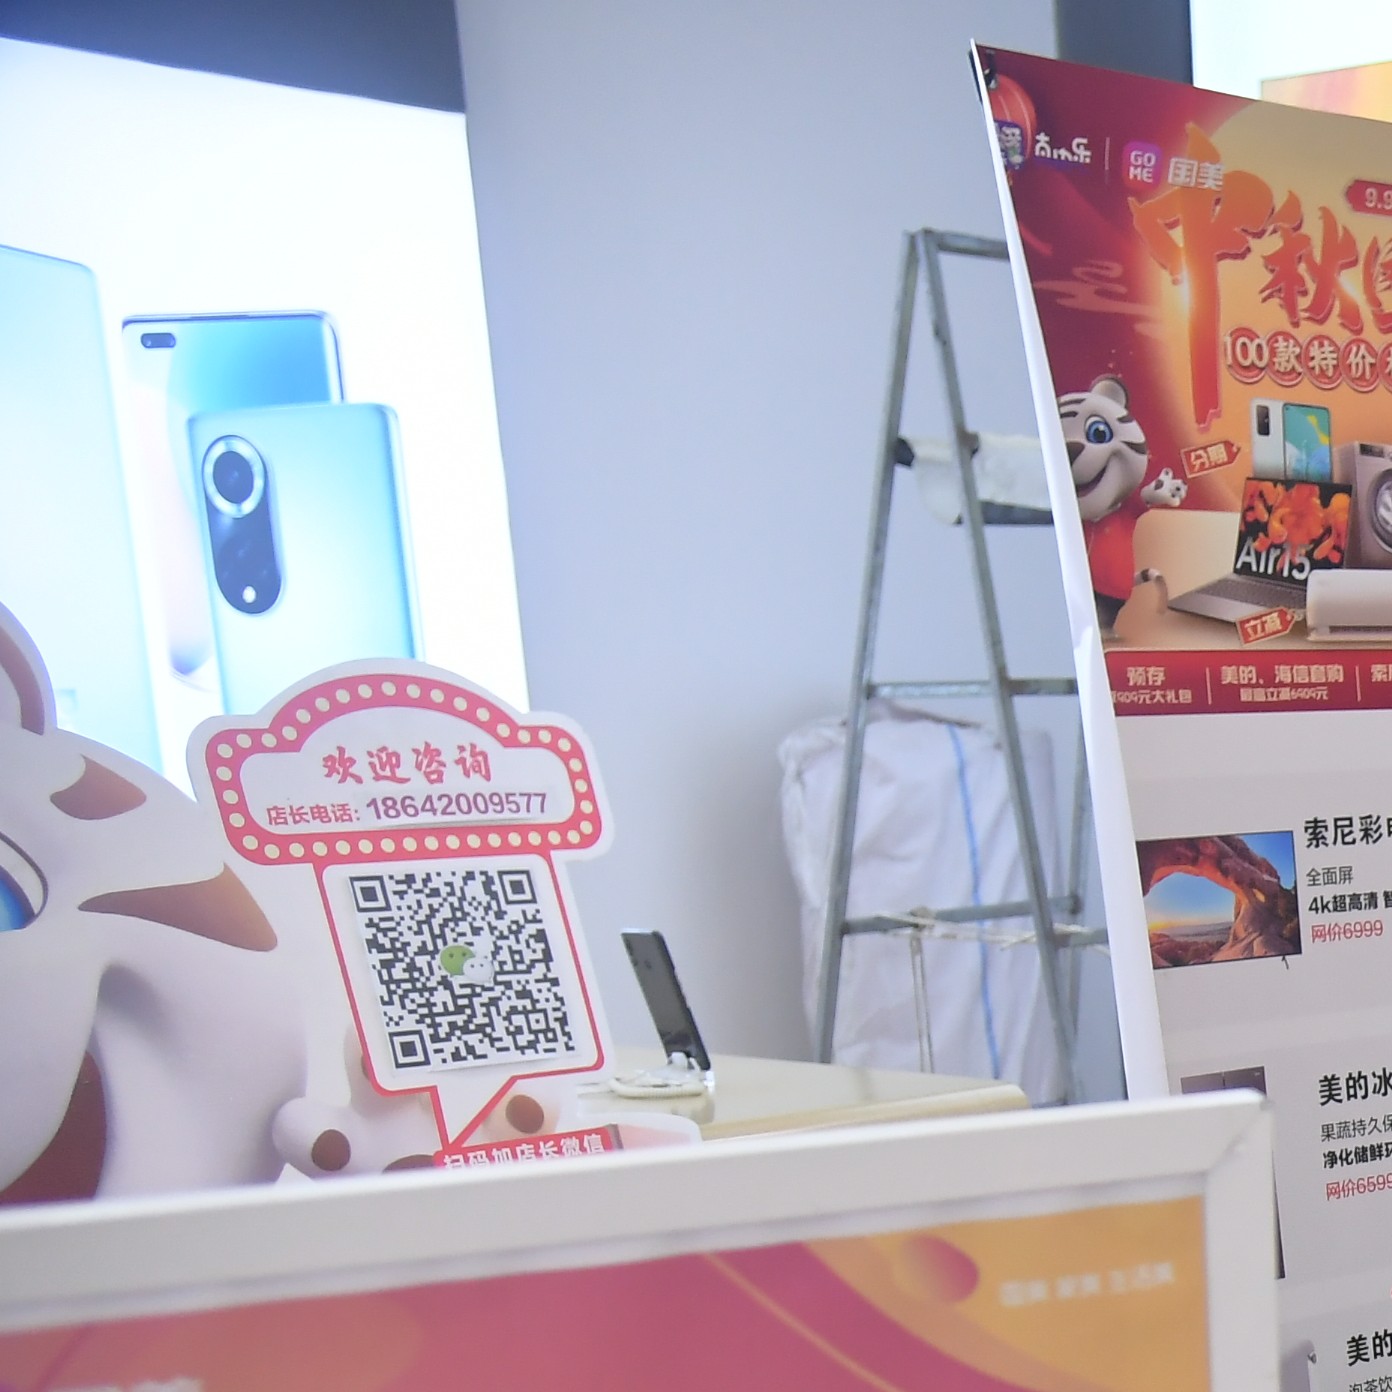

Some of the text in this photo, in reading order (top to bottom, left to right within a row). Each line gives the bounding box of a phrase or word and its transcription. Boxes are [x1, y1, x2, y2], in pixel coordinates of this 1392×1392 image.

[1130, 149, 1156, 168] GO
[1129, 166, 1153, 183] ME
[1167, 156, 1225, 192] 国美
[1188, 442, 1229, 471] 分期
[1126, 665, 1166, 687] 预存
[1220, 663, 1345, 685] 美的、海信套购
[321, 740, 492, 785] 欢迎咨询
[265, 791, 548, 827] 店长电话: 18642009577
[1305, 865, 1355, 888] 全面屏
[1308, 891, 1379, 915] 4k超高清
[1310, 919, 1385, 944] 网价6999
